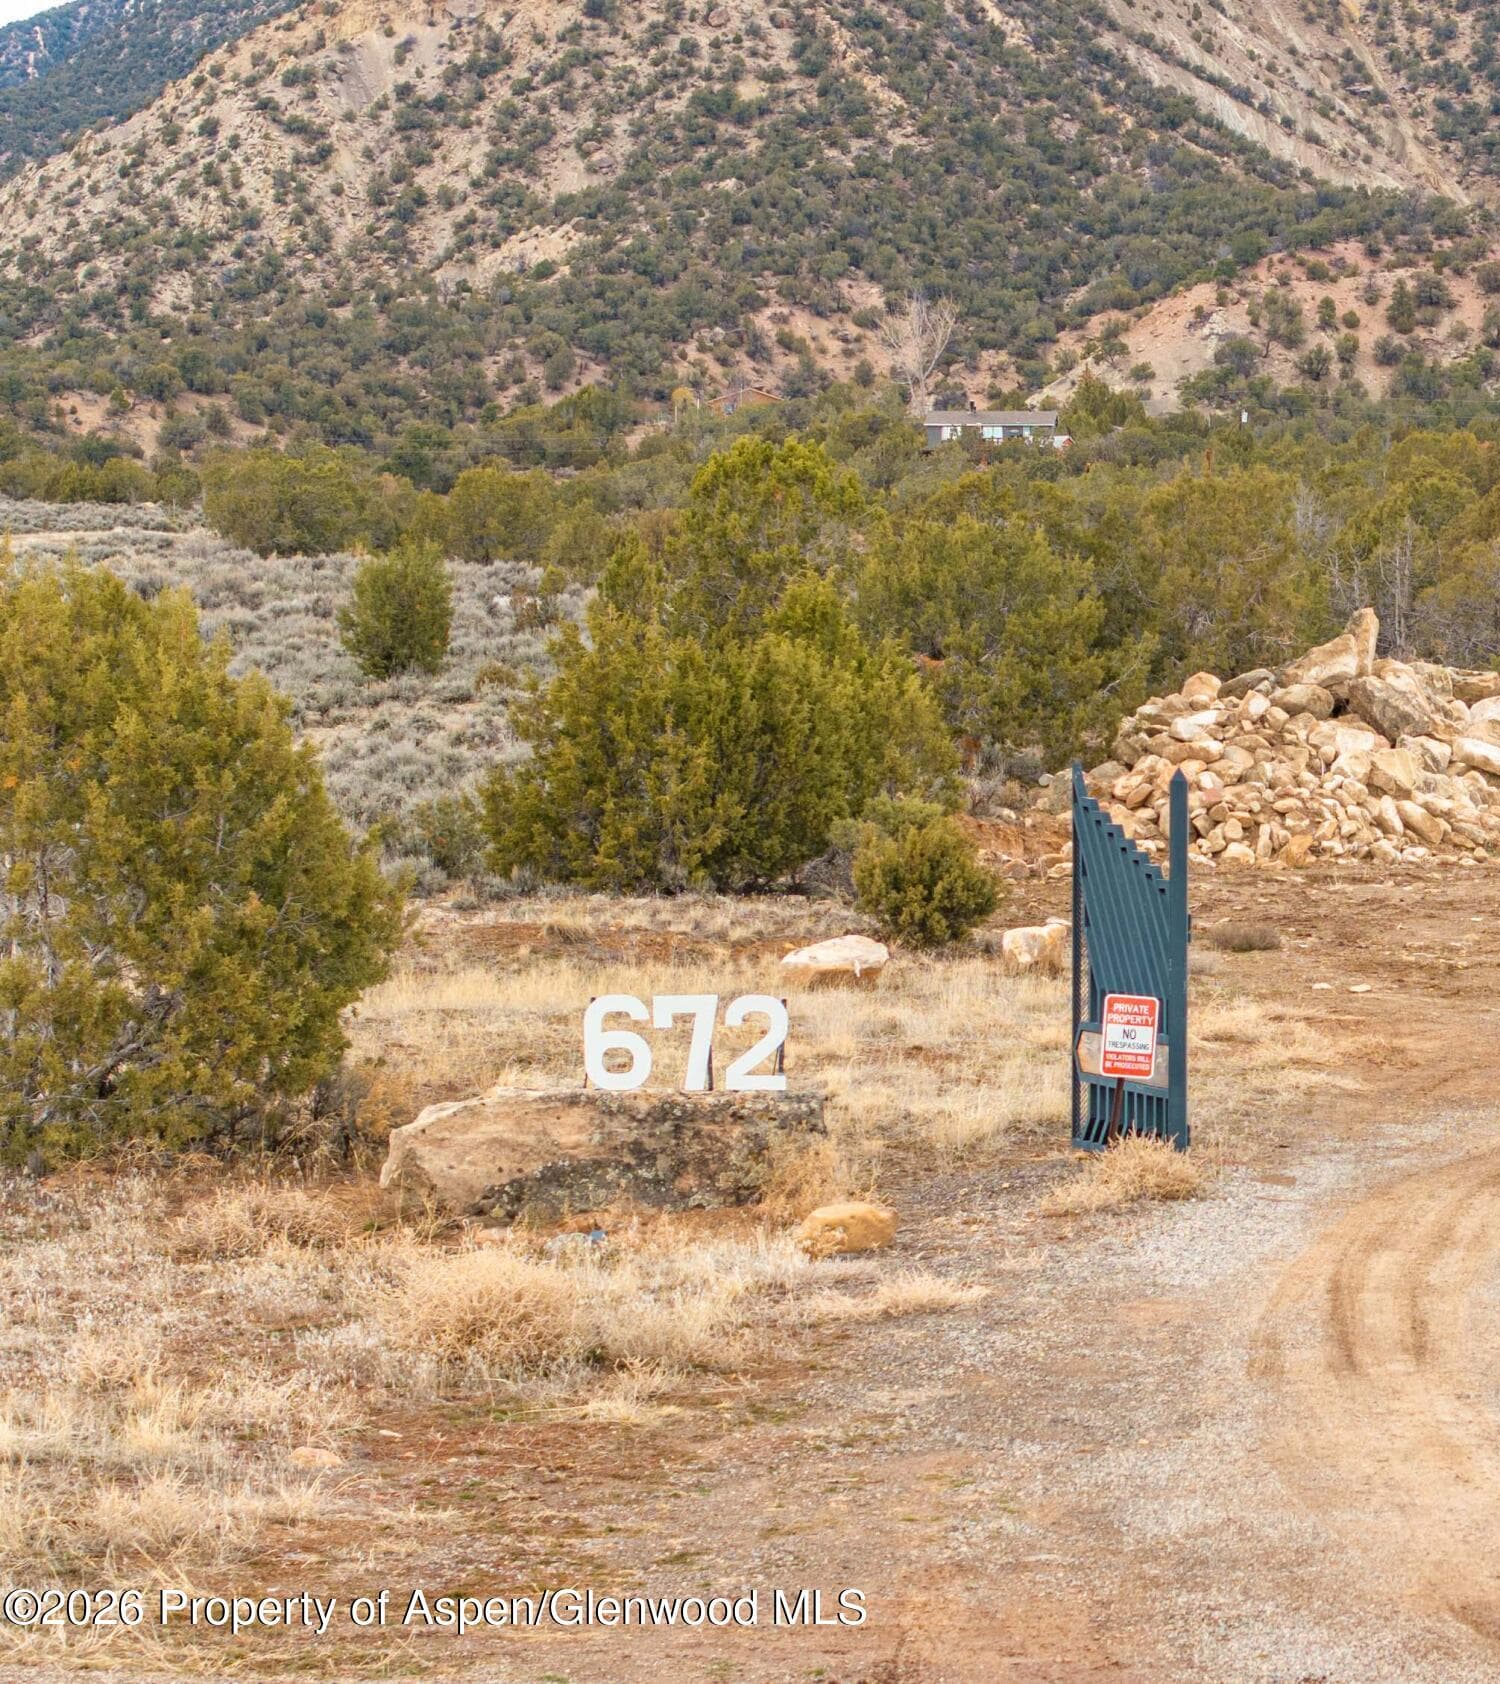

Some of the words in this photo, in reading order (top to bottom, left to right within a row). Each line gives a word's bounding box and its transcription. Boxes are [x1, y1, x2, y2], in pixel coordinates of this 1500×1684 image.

[1113, 1003, 1149, 1014] PRIVATE
[1107, 1013, 1154, 1025] PROPERTY
[1122, 1028, 1137, 1040] NO
[584, 994, 789, 1091] 672
[1108, 1041, 1150, 1051] TRESPASSING
